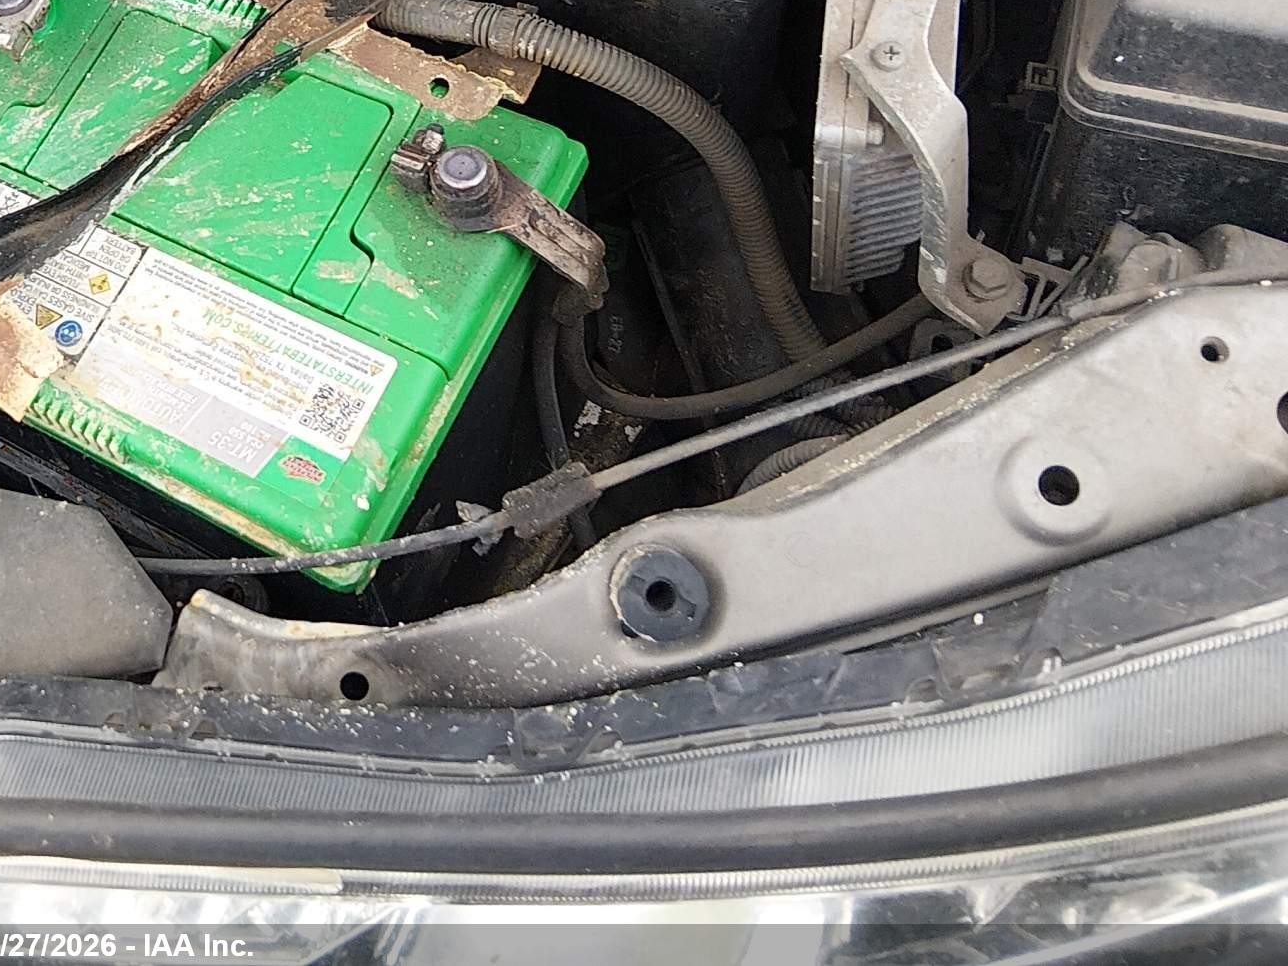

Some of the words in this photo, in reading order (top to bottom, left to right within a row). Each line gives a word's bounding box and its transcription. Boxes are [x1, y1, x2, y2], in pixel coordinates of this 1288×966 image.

[47, 294, 74, 313] GASES
[204, 307, 372, 394] INTERSTATEBATTERIES.COM
[208, 429, 256, 463] MT-35
